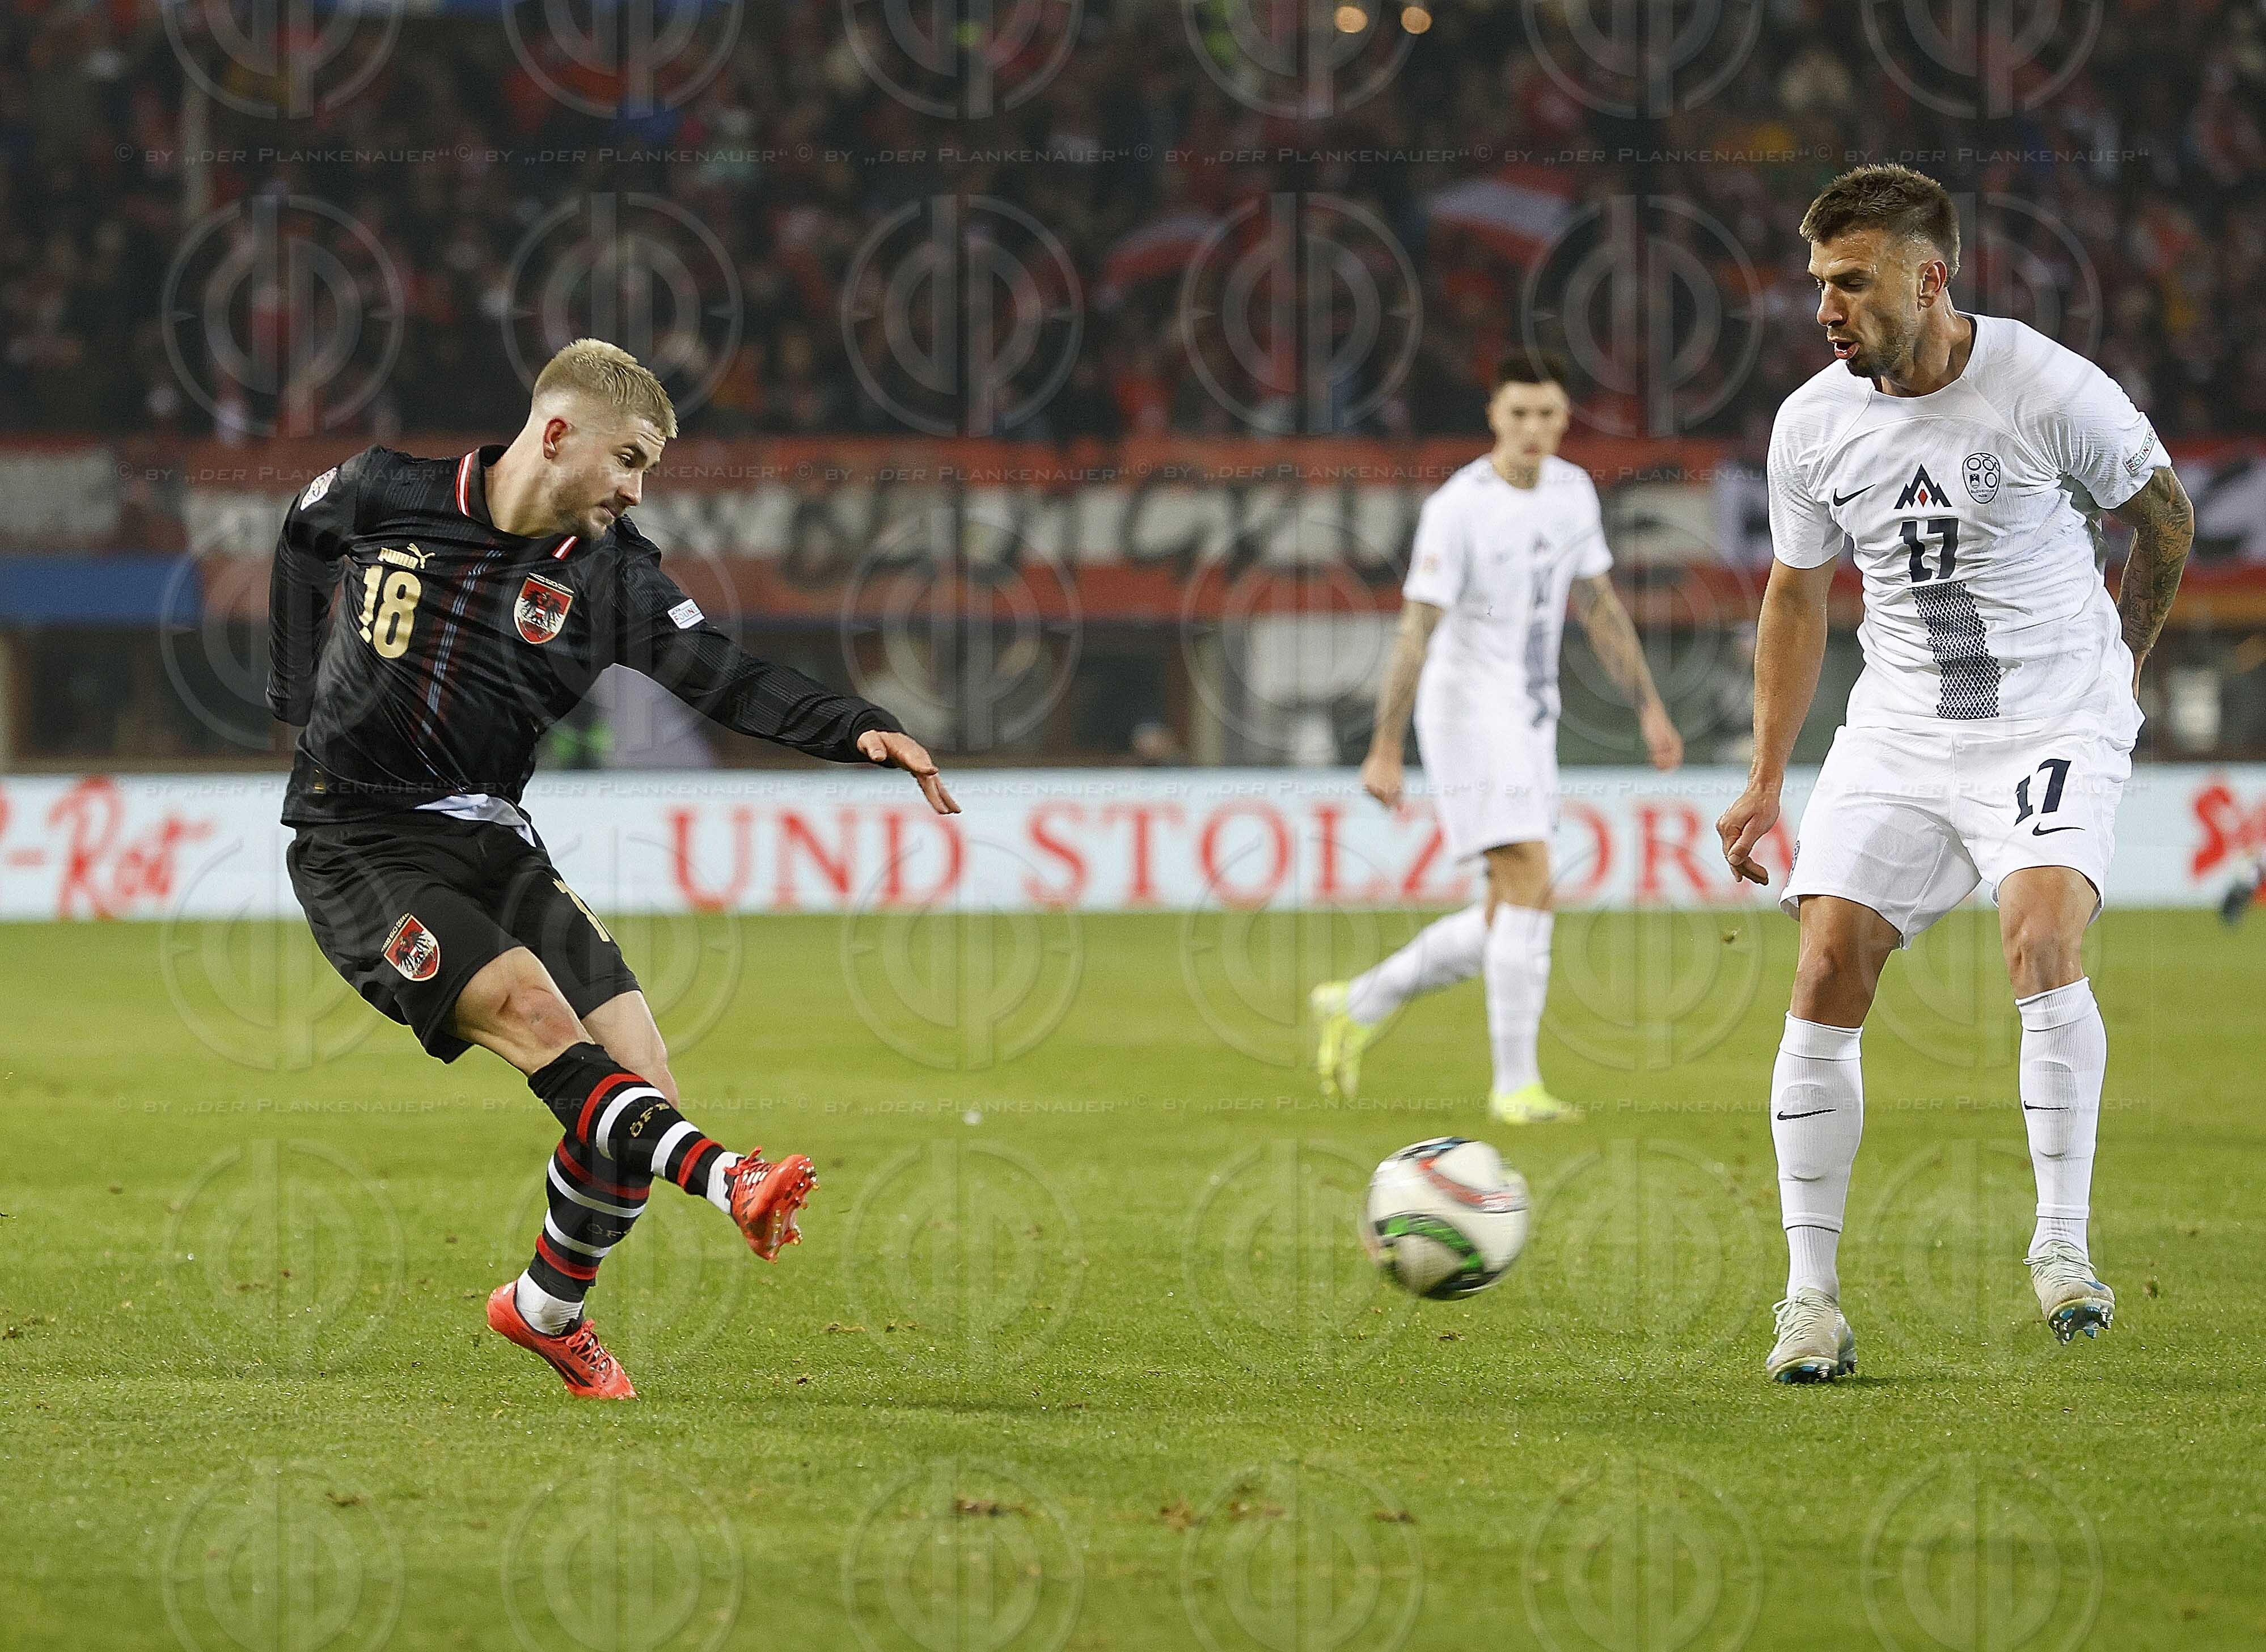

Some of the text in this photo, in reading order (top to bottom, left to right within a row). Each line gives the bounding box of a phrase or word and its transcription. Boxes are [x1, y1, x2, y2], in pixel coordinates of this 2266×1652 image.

[2128, 428, 2154, 471] FOUNDAT
[1898, 517, 1959, 583] 17
[358, 564, 422, 659] 18
[2014, 758, 2072, 827] 17
[665, 802, 966, 909] UND
